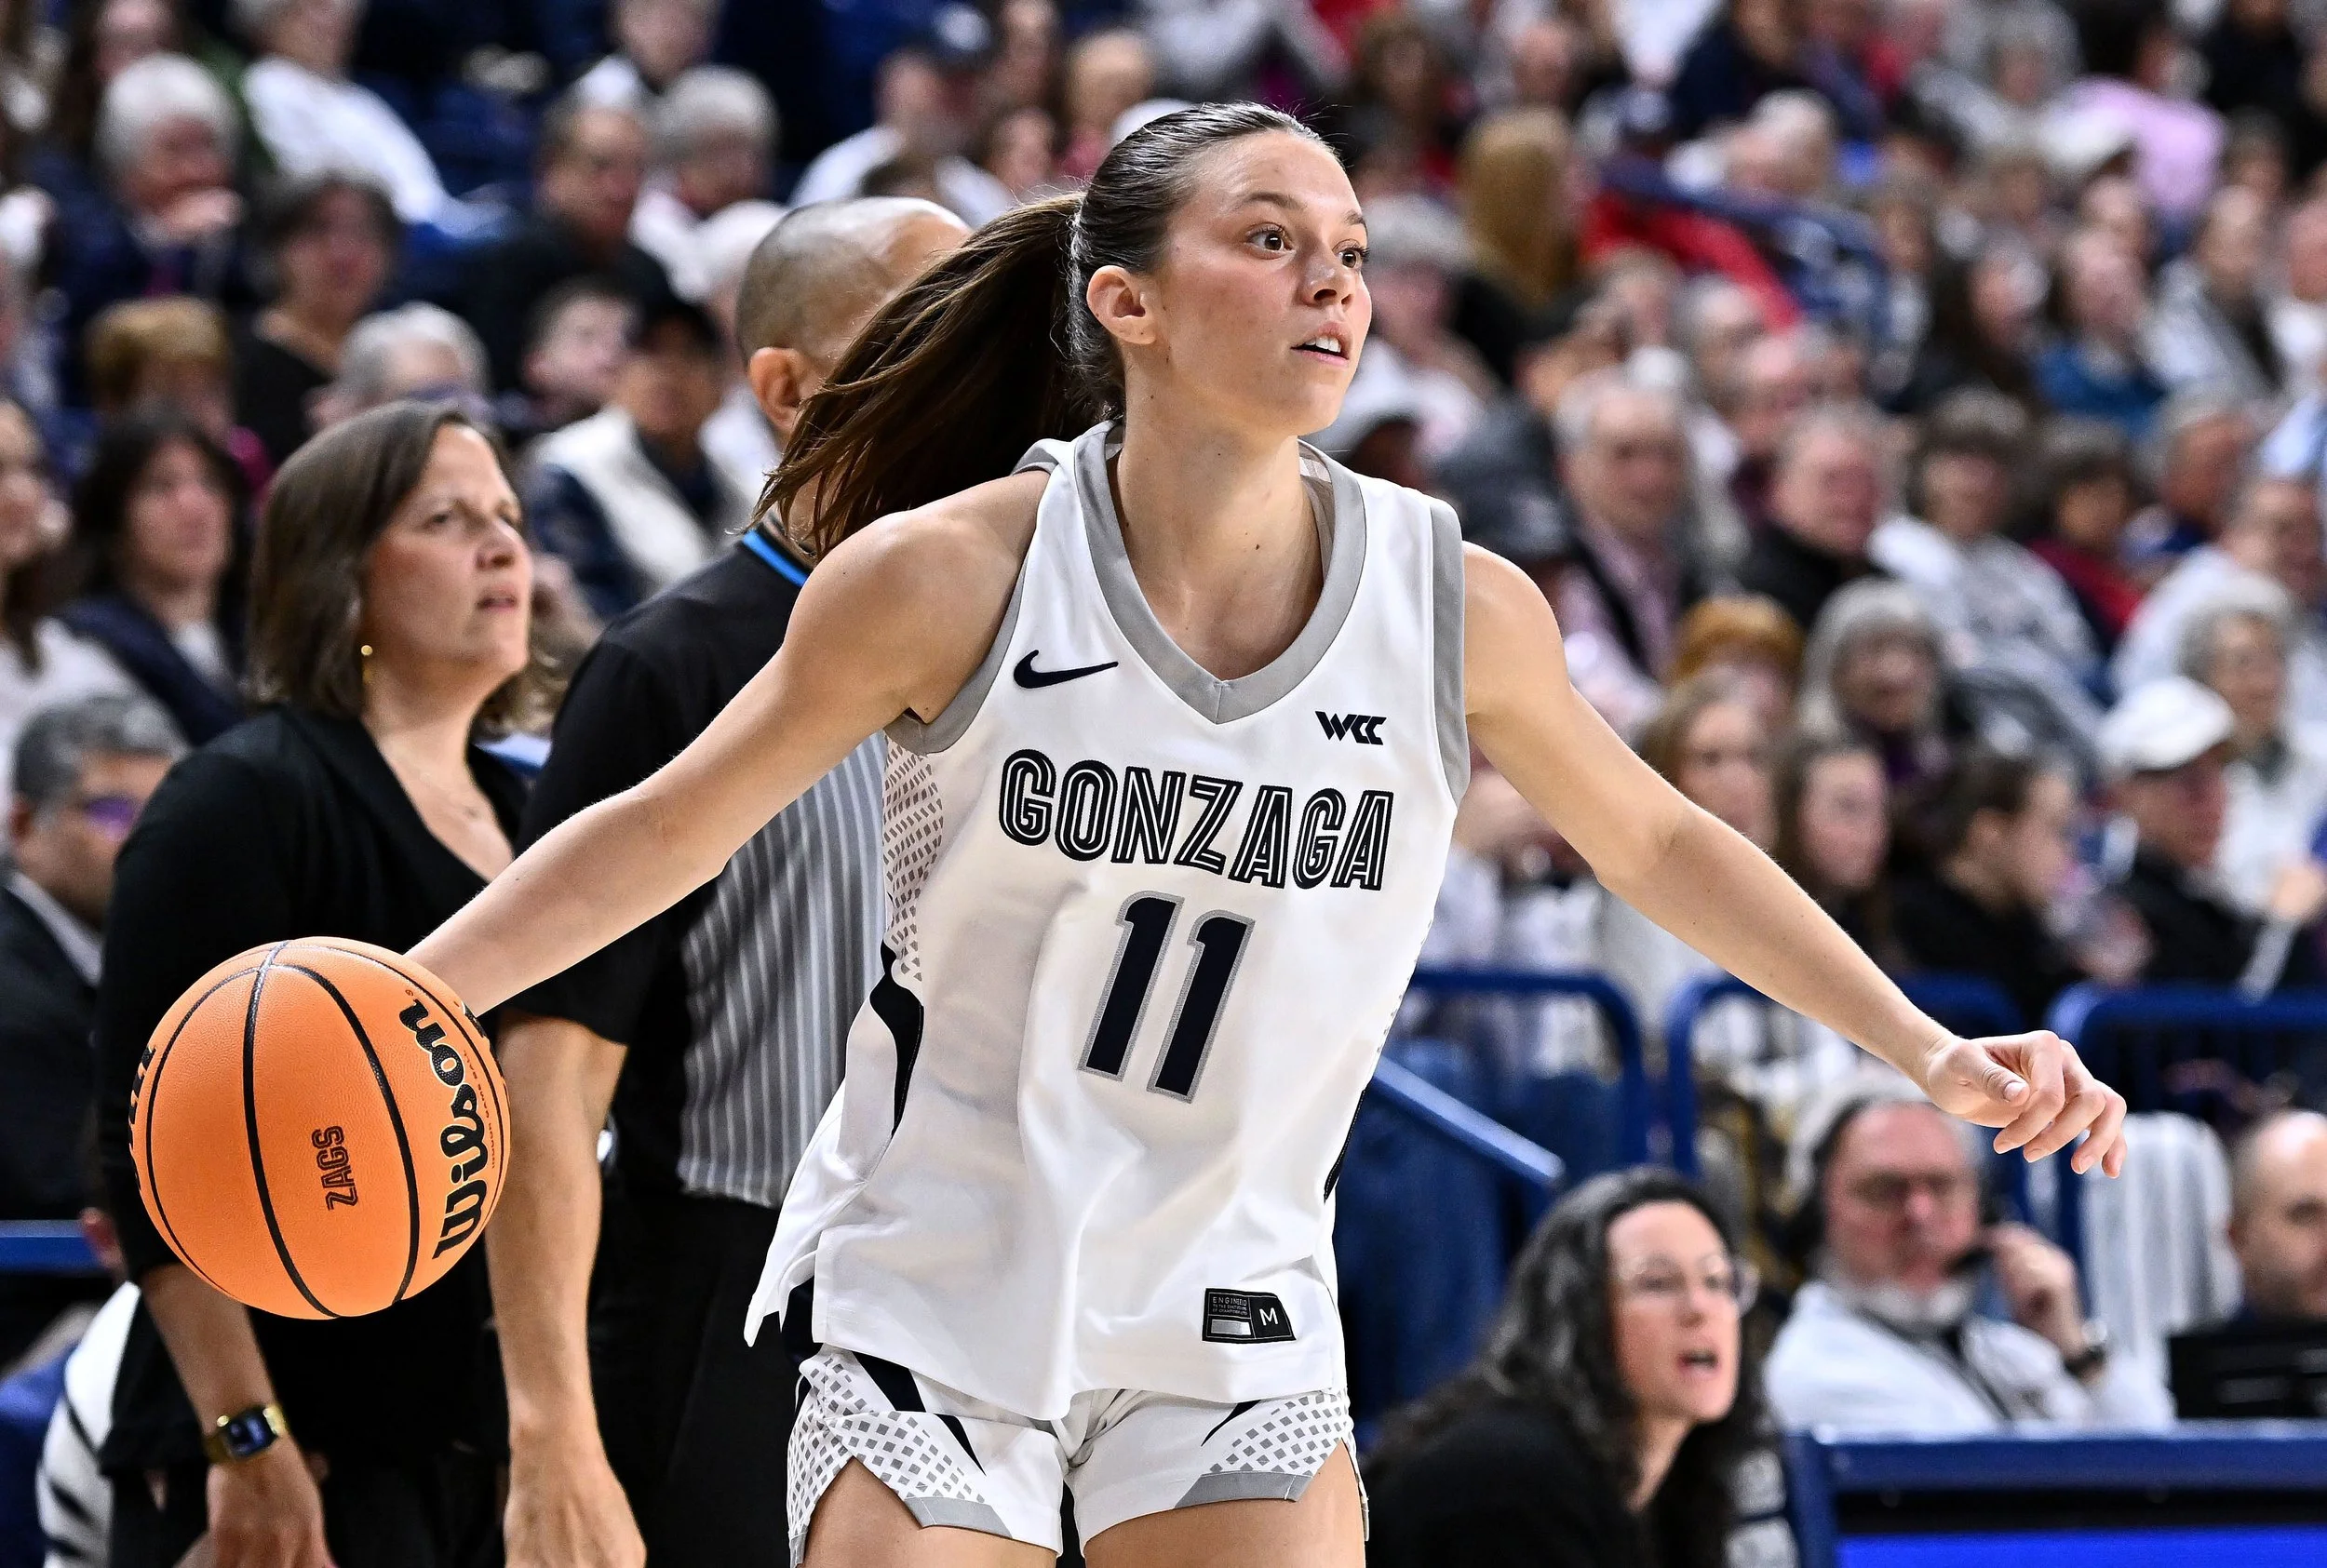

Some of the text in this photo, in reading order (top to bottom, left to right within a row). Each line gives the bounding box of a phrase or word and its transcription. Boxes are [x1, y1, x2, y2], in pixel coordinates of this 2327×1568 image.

[1314, 710, 1387, 745] WCC
[998, 748, 1394, 891] GONZAGA
[1077, 890, 1257, 1105] 11
[311, 1125, 358, 1211] ZAGS
[399, 999, 489, 1260] Wilson
[1259, 1307, 1279, 1326] M
